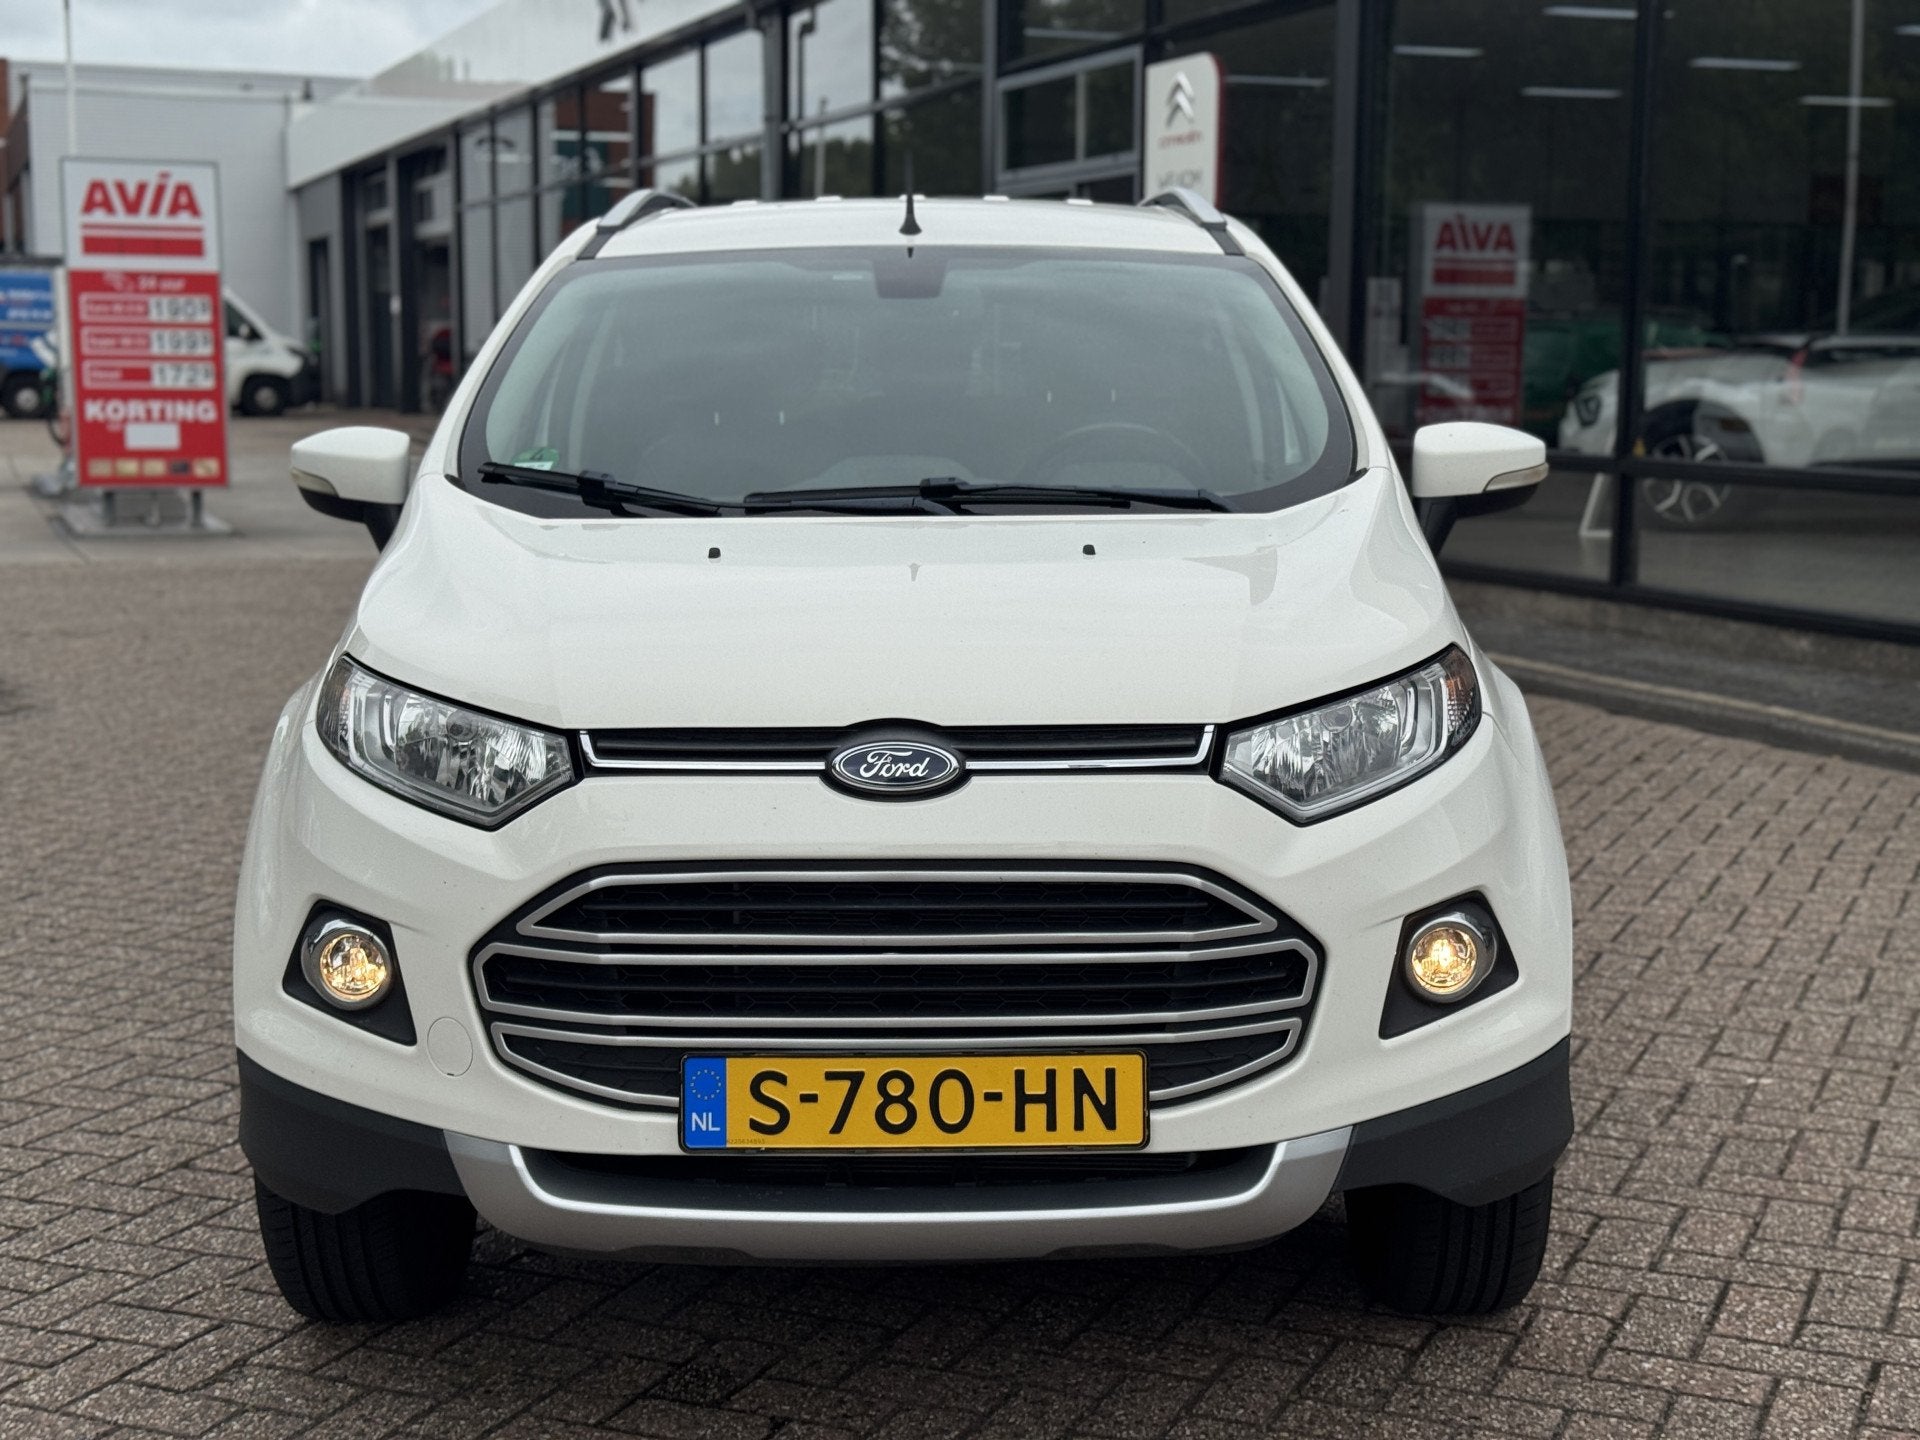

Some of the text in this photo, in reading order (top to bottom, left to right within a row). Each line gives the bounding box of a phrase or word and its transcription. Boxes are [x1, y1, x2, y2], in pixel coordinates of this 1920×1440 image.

[84, 399, 217, 423] KORTING
[859, 751, 931, 778] Ford
[748, 1067, 1117, 1136] S-780-HN
[691, 1112, 721, 1132] NL
